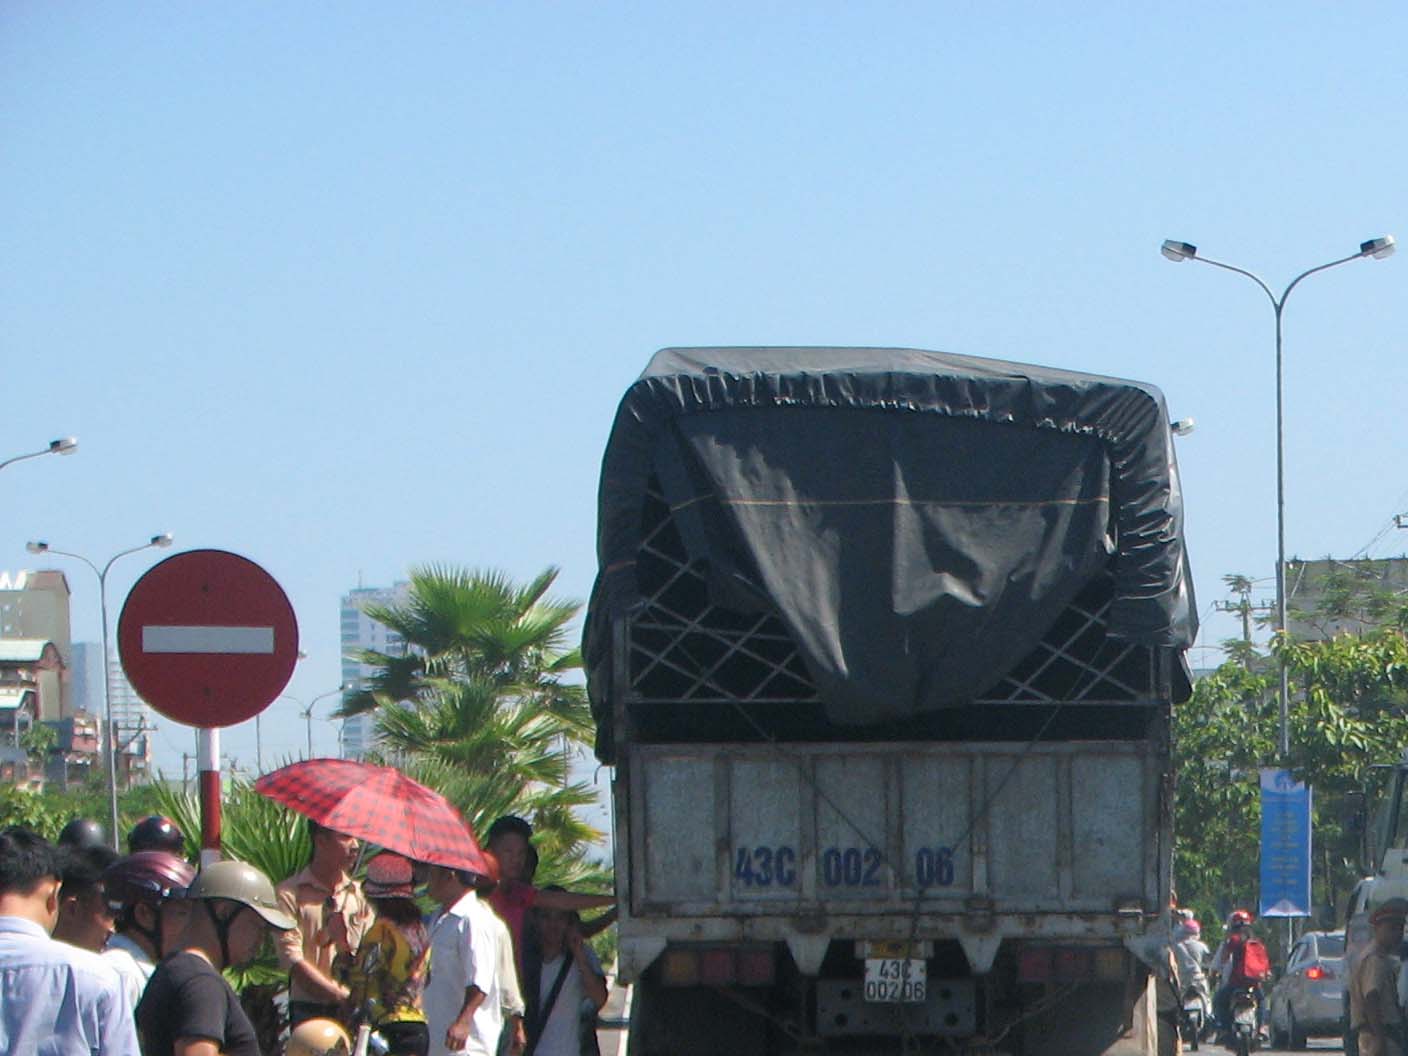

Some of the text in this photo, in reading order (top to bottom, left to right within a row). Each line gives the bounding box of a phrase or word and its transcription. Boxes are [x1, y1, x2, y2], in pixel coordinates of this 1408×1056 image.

[735, 846, 955, 887] 43C 002 06
[880, 959, 913, 980] 43C
